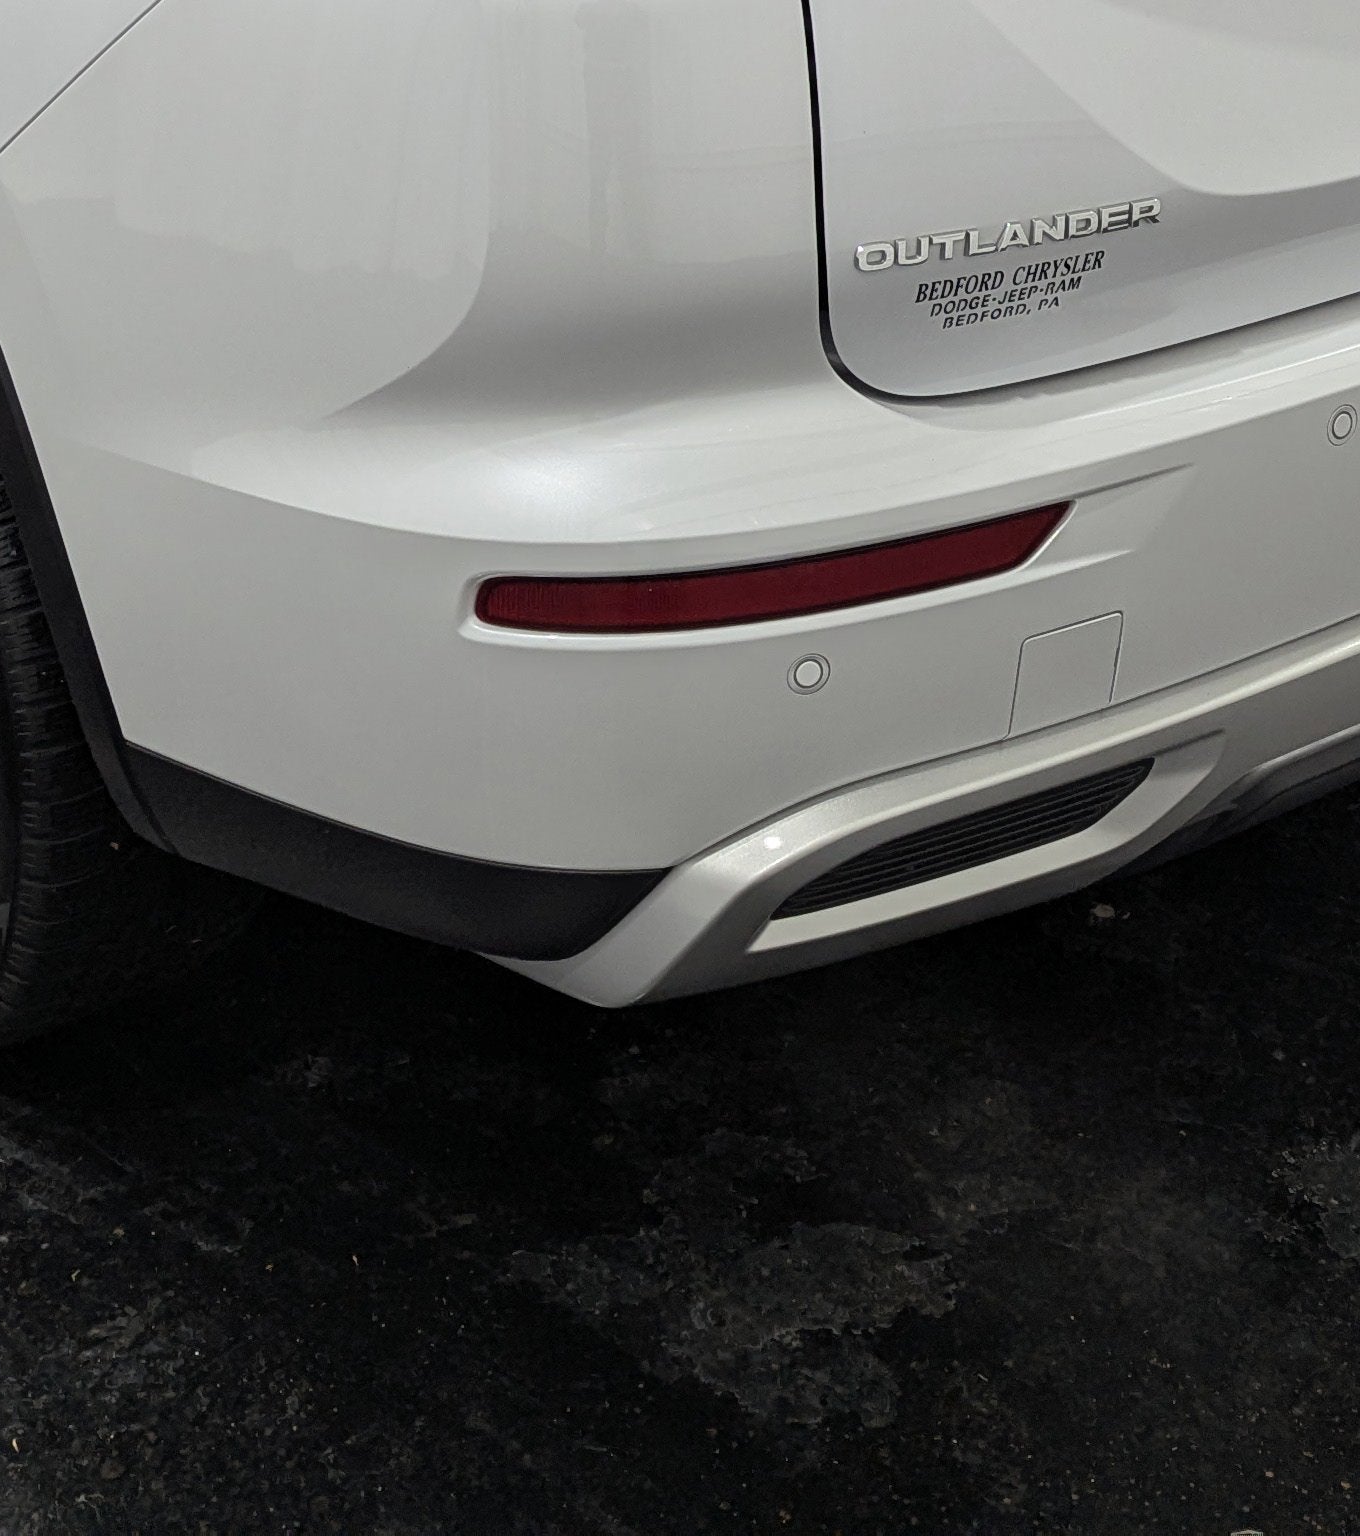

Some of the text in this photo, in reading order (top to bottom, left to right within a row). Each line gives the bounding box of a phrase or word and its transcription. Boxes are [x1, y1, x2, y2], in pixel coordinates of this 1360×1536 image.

[852, 196, 1162, 273] OUTLANDER
[914, 249, 1105, 304] BEDFORD CHRYSLER
[1037, 296, 1061, 312] PA
